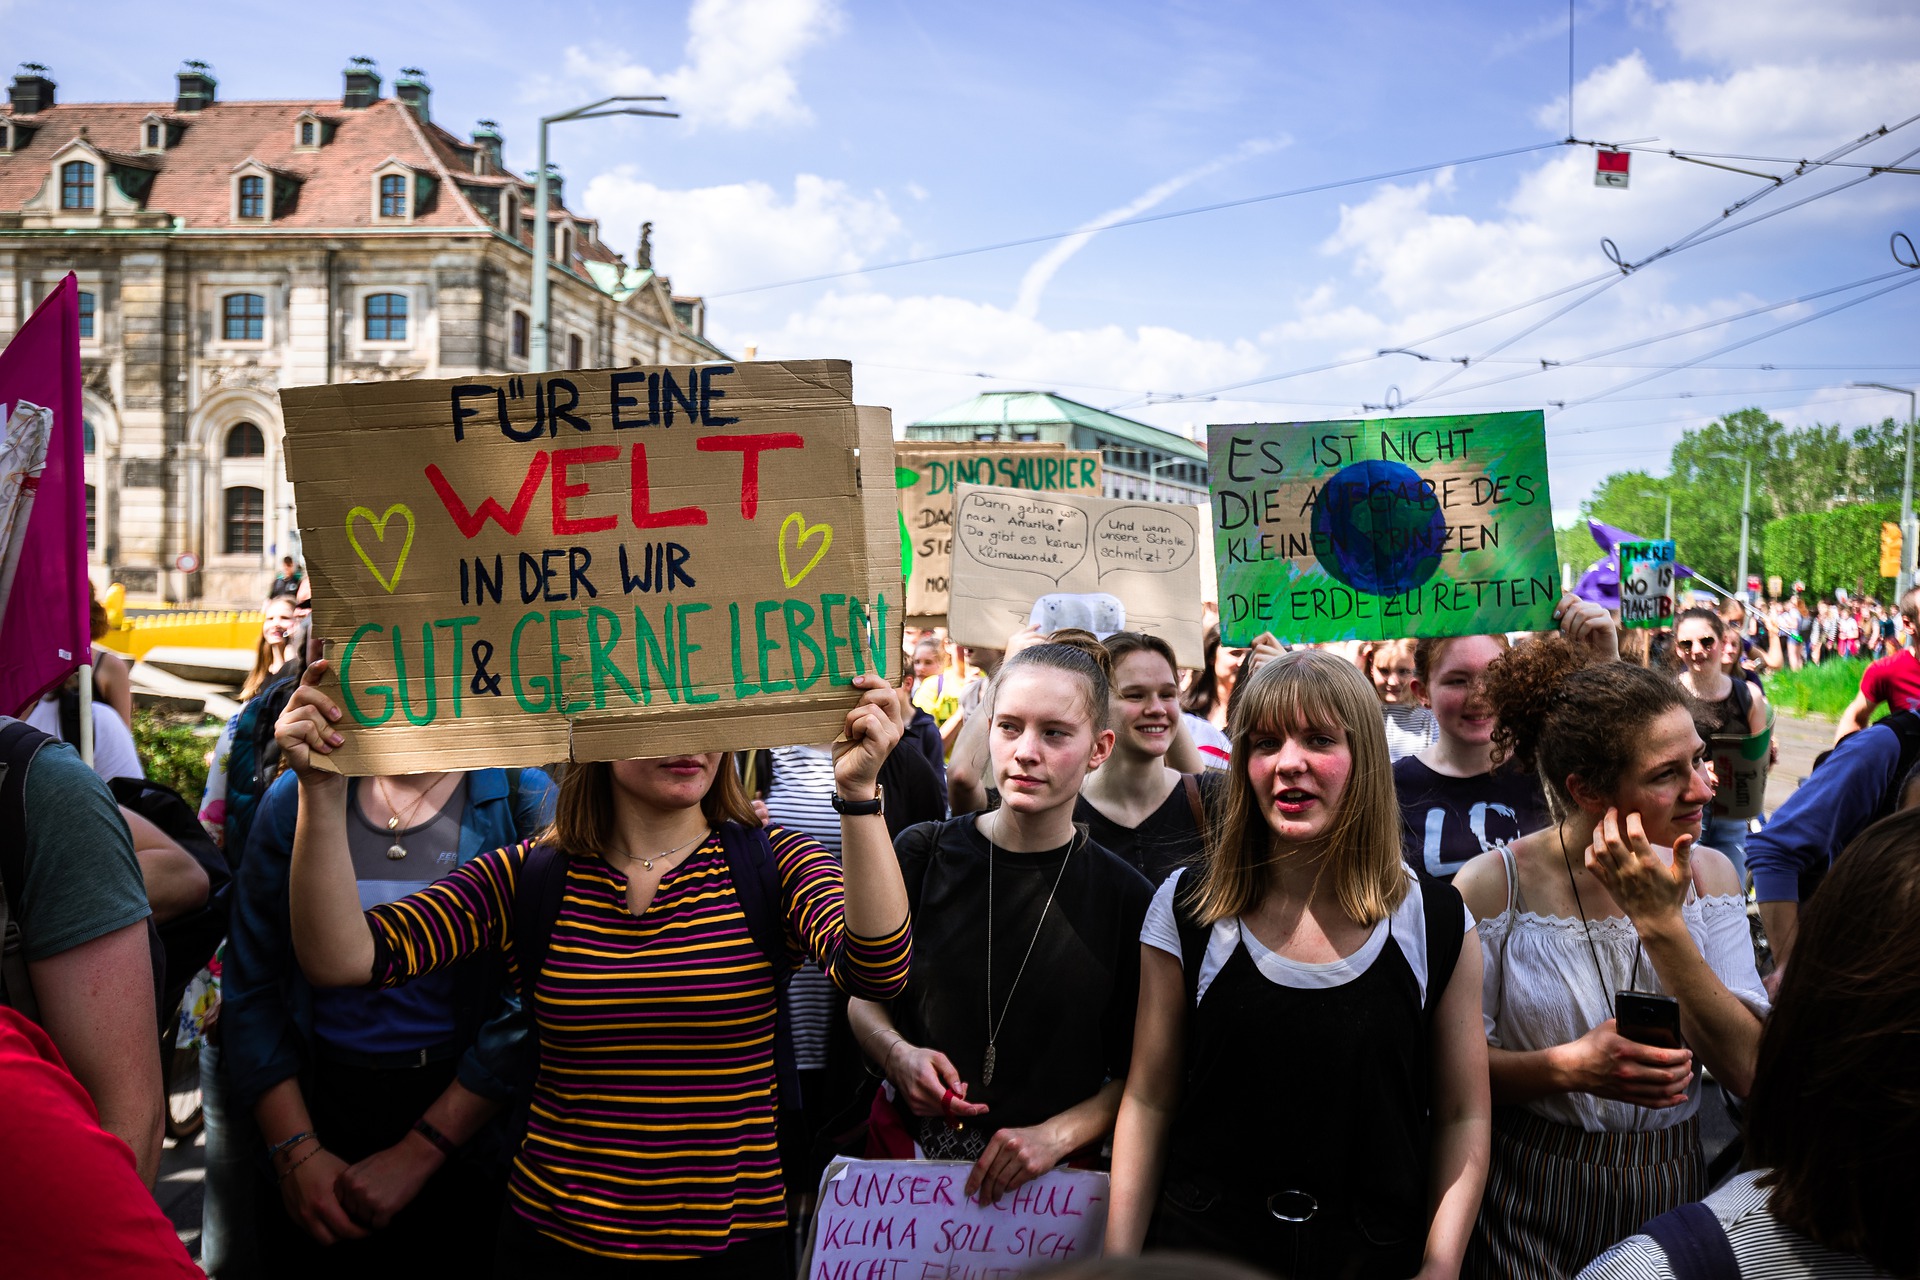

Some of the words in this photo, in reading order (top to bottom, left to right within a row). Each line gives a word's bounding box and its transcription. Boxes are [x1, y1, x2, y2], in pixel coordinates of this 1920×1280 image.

[451, 380, 591, 442] FÜR
[611, 366, 740, 430] EINE
[1227, 437, 1283, 482] ES
[1312, 434, 1358, 468] IST
[1381, 428, 1474, 463] NICHT
[424, 433, 804, 539] WELT
[926, 457, 1097, 495] DINOSAURIER
[966, 513, 996, 523] nach
[973, 495, 1010, 511] Dann
[1018, 503, 1054, 519] gehen
[1218, 489, 1282, 530] DIE
[1299, 476, 1461, 518] AUFGABE
[1470, 475, 1536, 507] DES
[963, 525, 984, 536] Da
[988, 530, 1015, 545] gibt
[1021, 536, 1037, 545] es
[1099, 533, 1140, 543] unsere
[1109, 520, 1134, 531] Und
[1142, 524, 1171, 533] wenn
[1100, 546, 1162, 562] schmilzt
[1227, 530, 1348, 565] KLEINEN
[1364, 521, 1501, 558] PRINZEN
[1620, 545, 1672, 562] THERE
[459, 553, 503, 605] IN
[519, 547, 597, 602] DER
[619, 542, 697, 594] WIR
[1624, 579, 1648, 596] NO
[1658, 568, 1673, 588] IS
[1227, 592, 1272, 623] DIE
[1291, 587, 1373, 620] ERDE
[1384, 586, 1424, 619] ZU
[1434, 574, 1556, 612] RETTEN
[1659, 595, 1673, 618] B
[340, 616, 481, 727] GUT
[510, 602, 720, 715] GERNE
[730, 592, 889, 700] LEBEN
[833, 1173, 955, 1208] UNSER
[970, 1184, 1101, 1217] CHUL-
[822, 1215, 917, 1251] KLIMA
[933, 1219, 997, 1254] SOLL
[1007, 1226, 1076, 1261] SICH
[817, 1257, 908, 1280] NICHT
